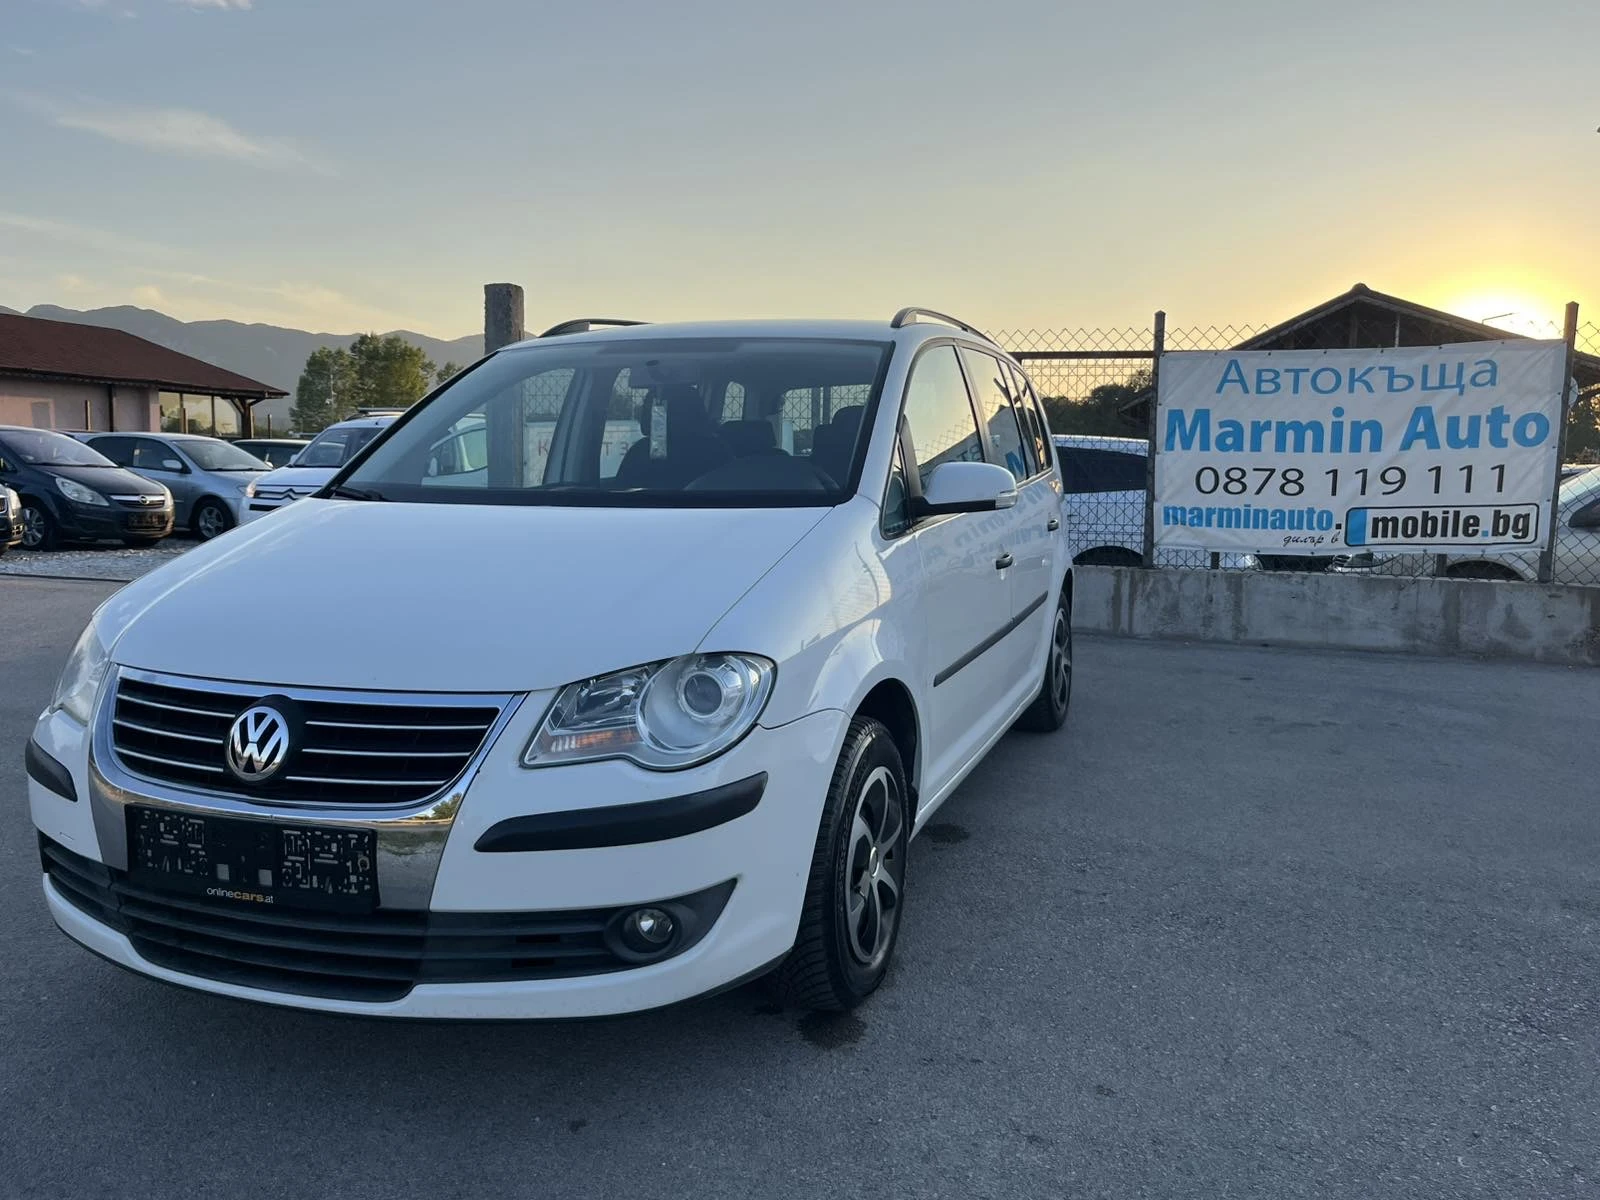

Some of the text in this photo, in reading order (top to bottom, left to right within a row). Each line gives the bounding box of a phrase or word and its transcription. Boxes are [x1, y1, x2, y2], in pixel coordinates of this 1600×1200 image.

[1215, 358, 1499, 396] Автокъща
[1164, 405, 1551, 453] Marmin Auto
[1194, 464, 1506, 497] 0878 119 111
[1371, 508, 1531, 540] mobile.bg
